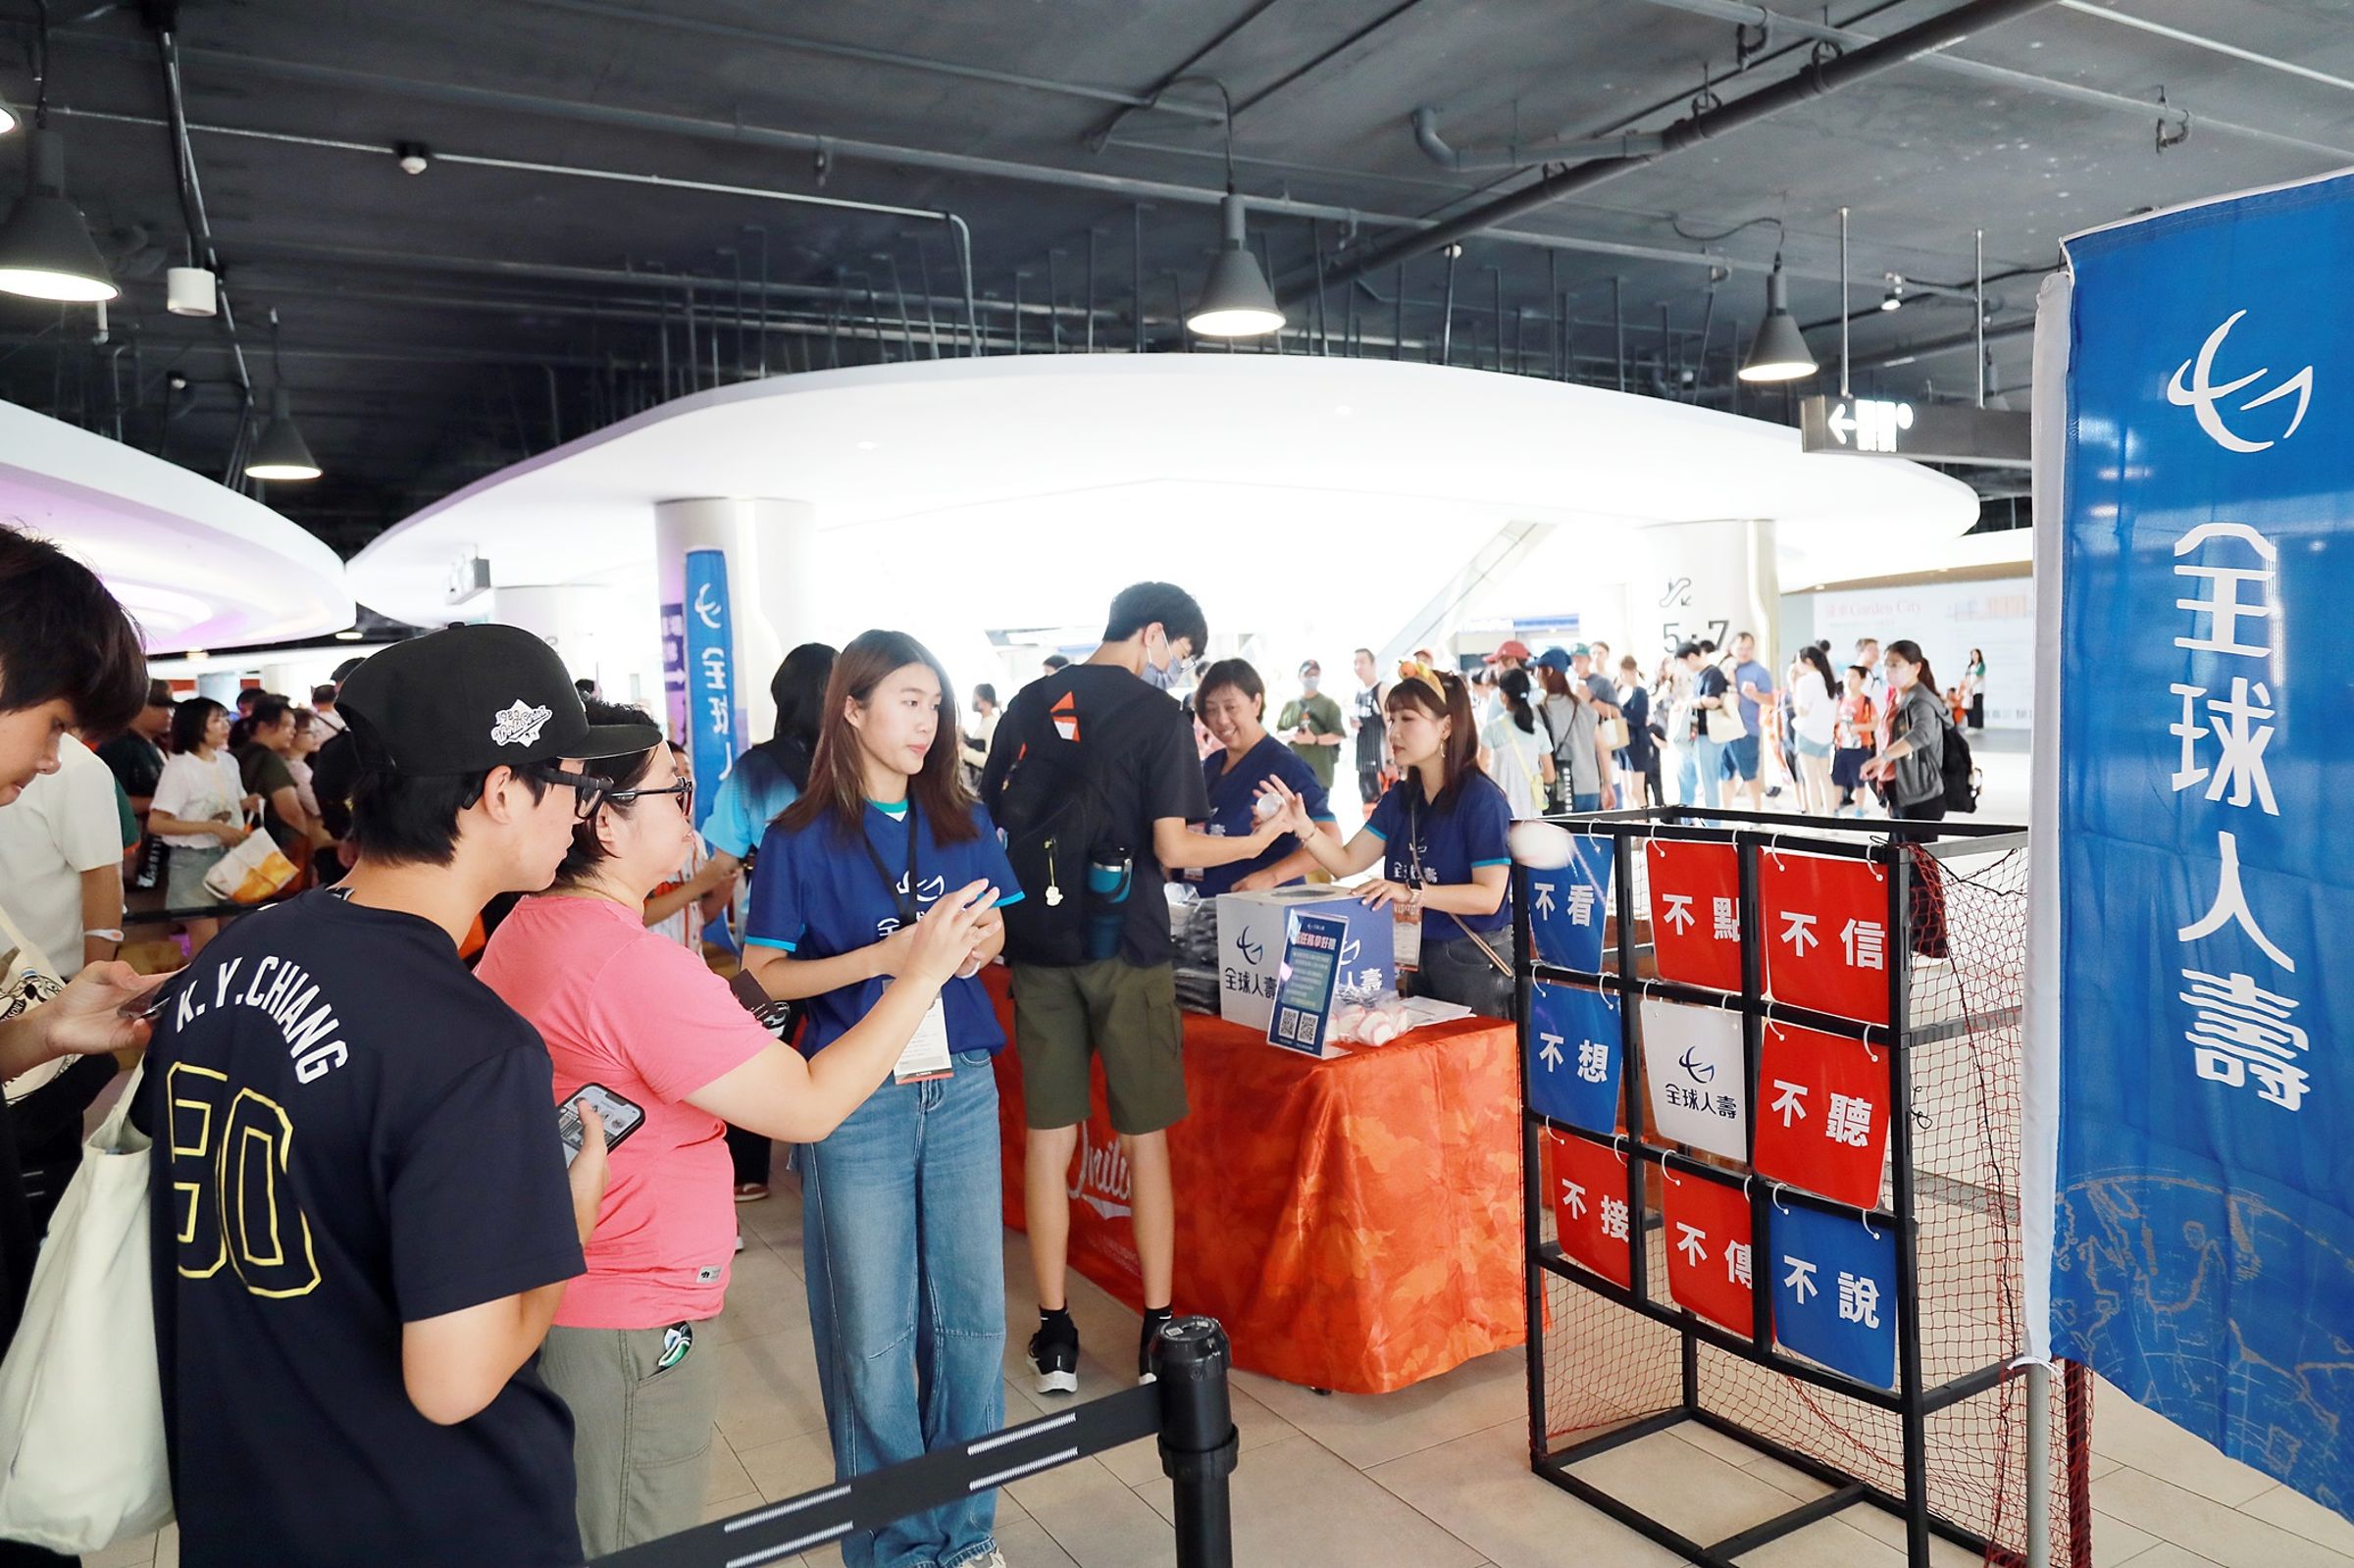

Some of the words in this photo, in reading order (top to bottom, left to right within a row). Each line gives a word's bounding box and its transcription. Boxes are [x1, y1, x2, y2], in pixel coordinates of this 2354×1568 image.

[2171, 521, 2312, 1112] 全球人壽
[1534, 882, 1596, 928] 不看
[1662, 892, 1741, 942] 不點
[1779, 910, 1886, 971] 不信
[1224, 967, 1278, 1001] 全球人壽
[1336, 967, 1383, 994] 人壽
[1539, 1032, 1610, 1084] 不想
[1664, 1082, 1738, 1120] 全球人壽
[1770, 1078, 1874, 1148] 不聽
[1561, 1179, 1631, 1243] 不接
[1782, 1254, 1881, 1330] 不說
